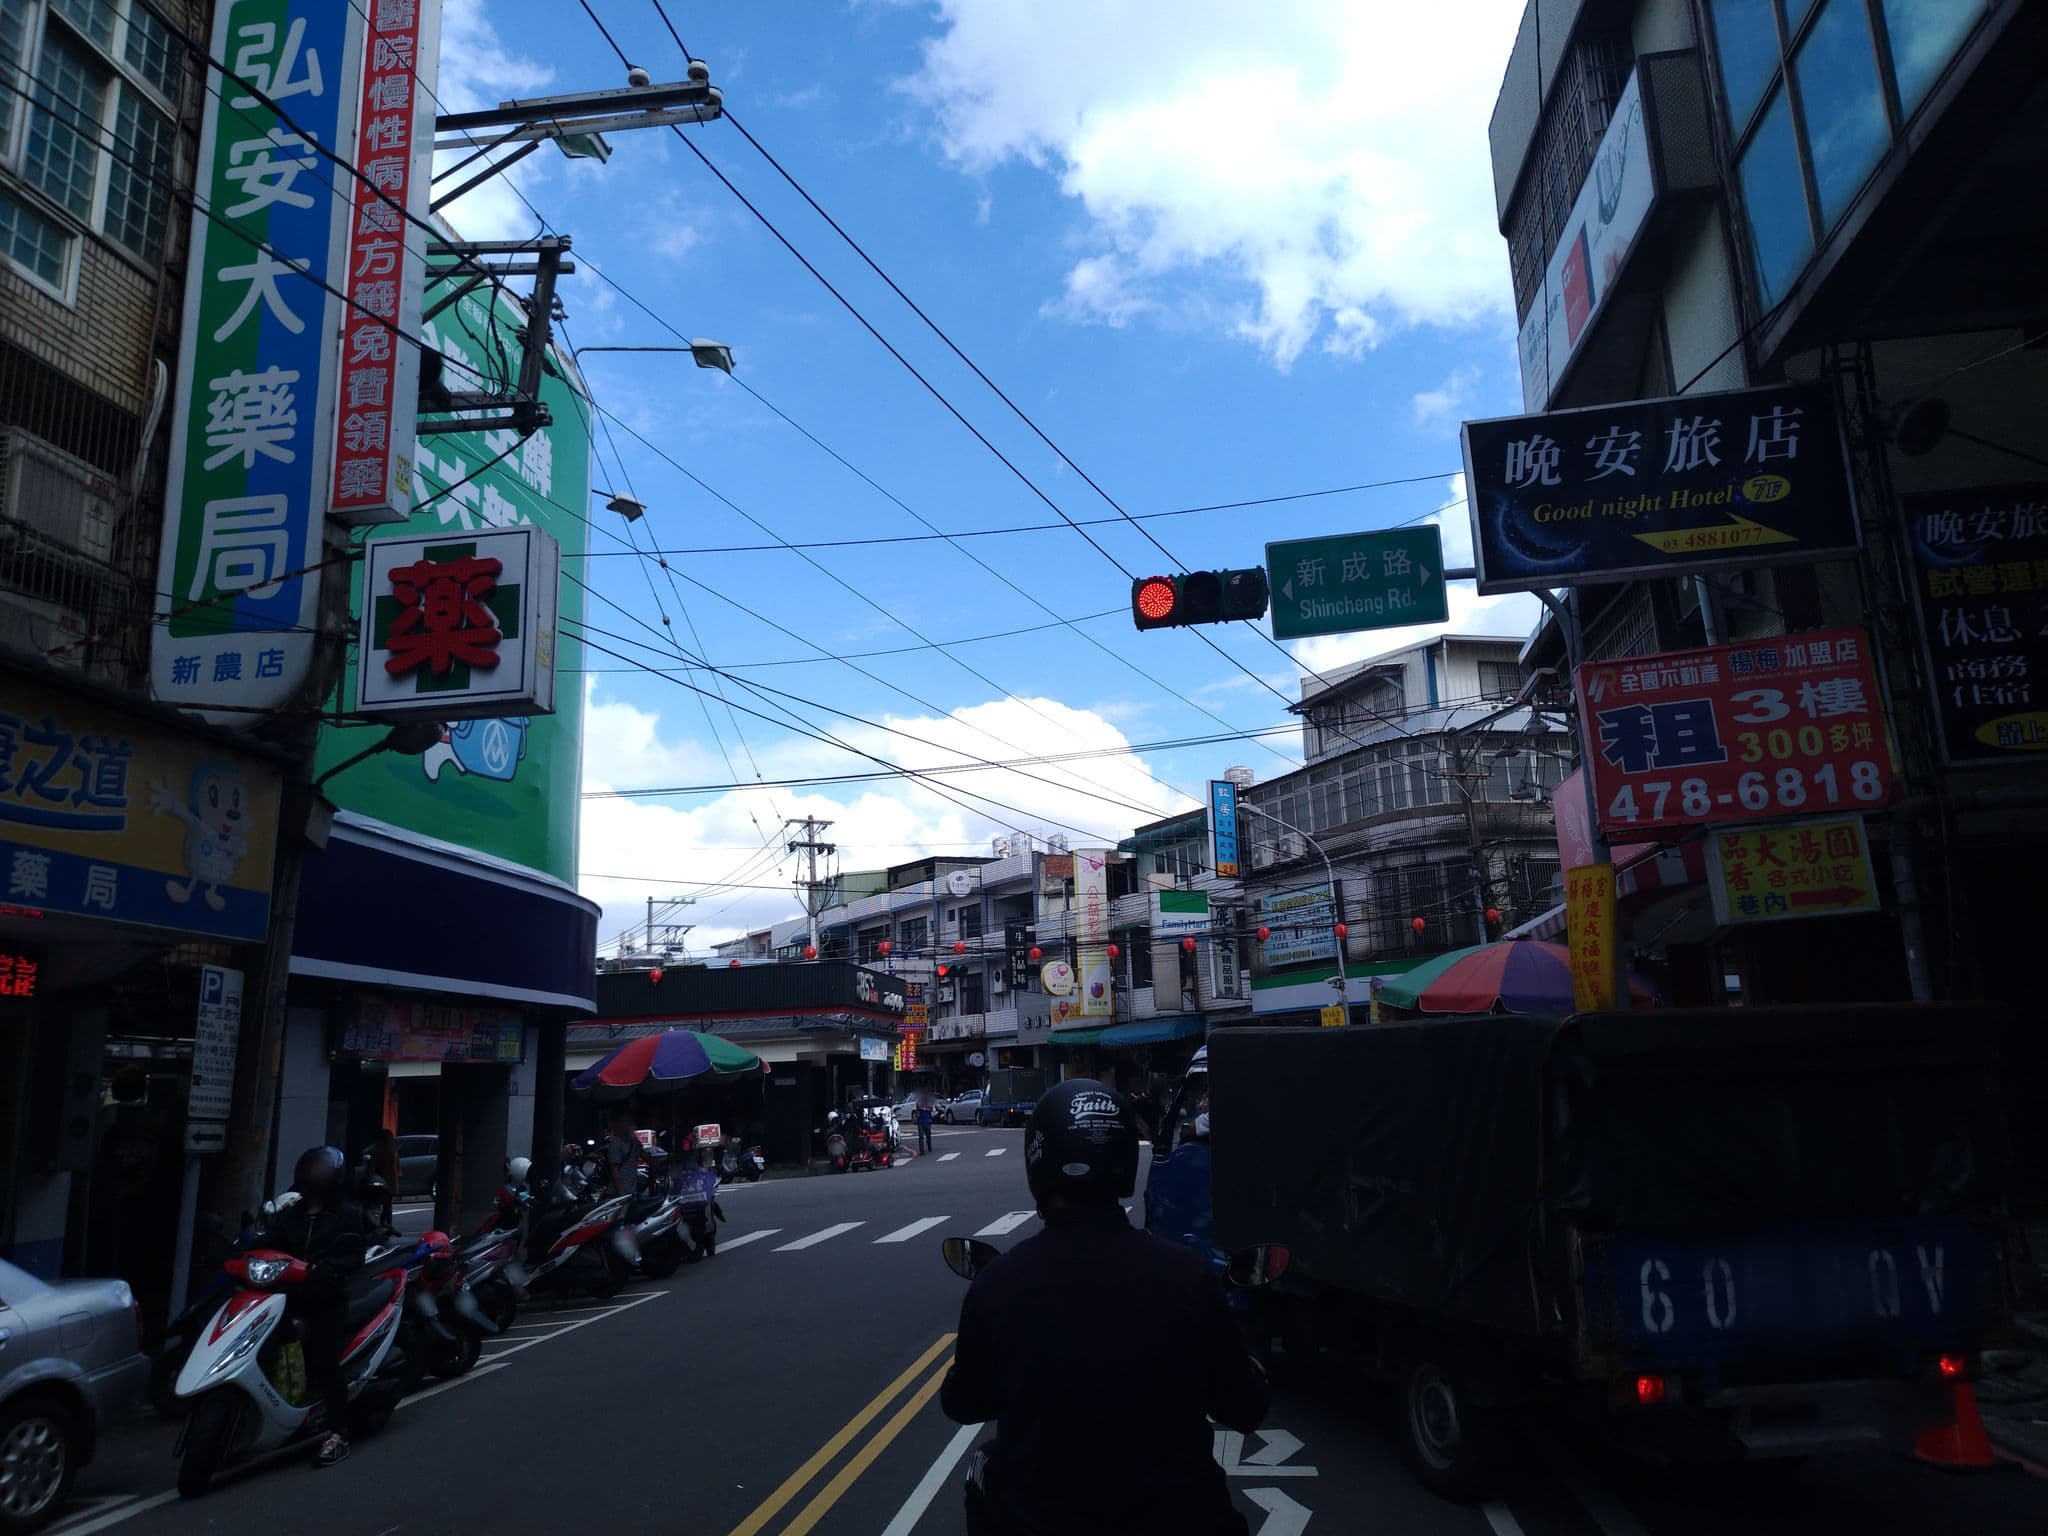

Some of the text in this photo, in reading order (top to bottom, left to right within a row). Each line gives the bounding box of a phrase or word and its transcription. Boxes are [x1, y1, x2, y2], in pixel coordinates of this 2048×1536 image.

[188, 17, 324, 602] 弘安大藥局
[1503, 406, 1806, 491] 晚安旅店
[1533, 479, 1783, 524] Good night Hotel 7F
[1684, 526, 1762, 549] 4881077
[1296, 547, 1413, 588] 新成路
[1299, 585, 1418, 621] Shincheng Rd.
[1938, 605, 2024, 648] 休息
[172, 649, 285, 686] 新農店
[1729, 648, 1781, 675] 楊梅
[1784, 638, 1858, 669] 加盟店
[1620, 663, 1721, 694] 全國不動產
[1730, 677, 1869, 724] 3樓
[1597, 698, 1728, 775] 租
[1736, 722, 1873, 764] 300多坪
[1608, 760, 1883, 823] 478-6818
[8, 850, 120, 912] 藥局
[1162, 919, 1208, 931] FamilyMart
[1069, 1096, 1120, 1117] Faith
